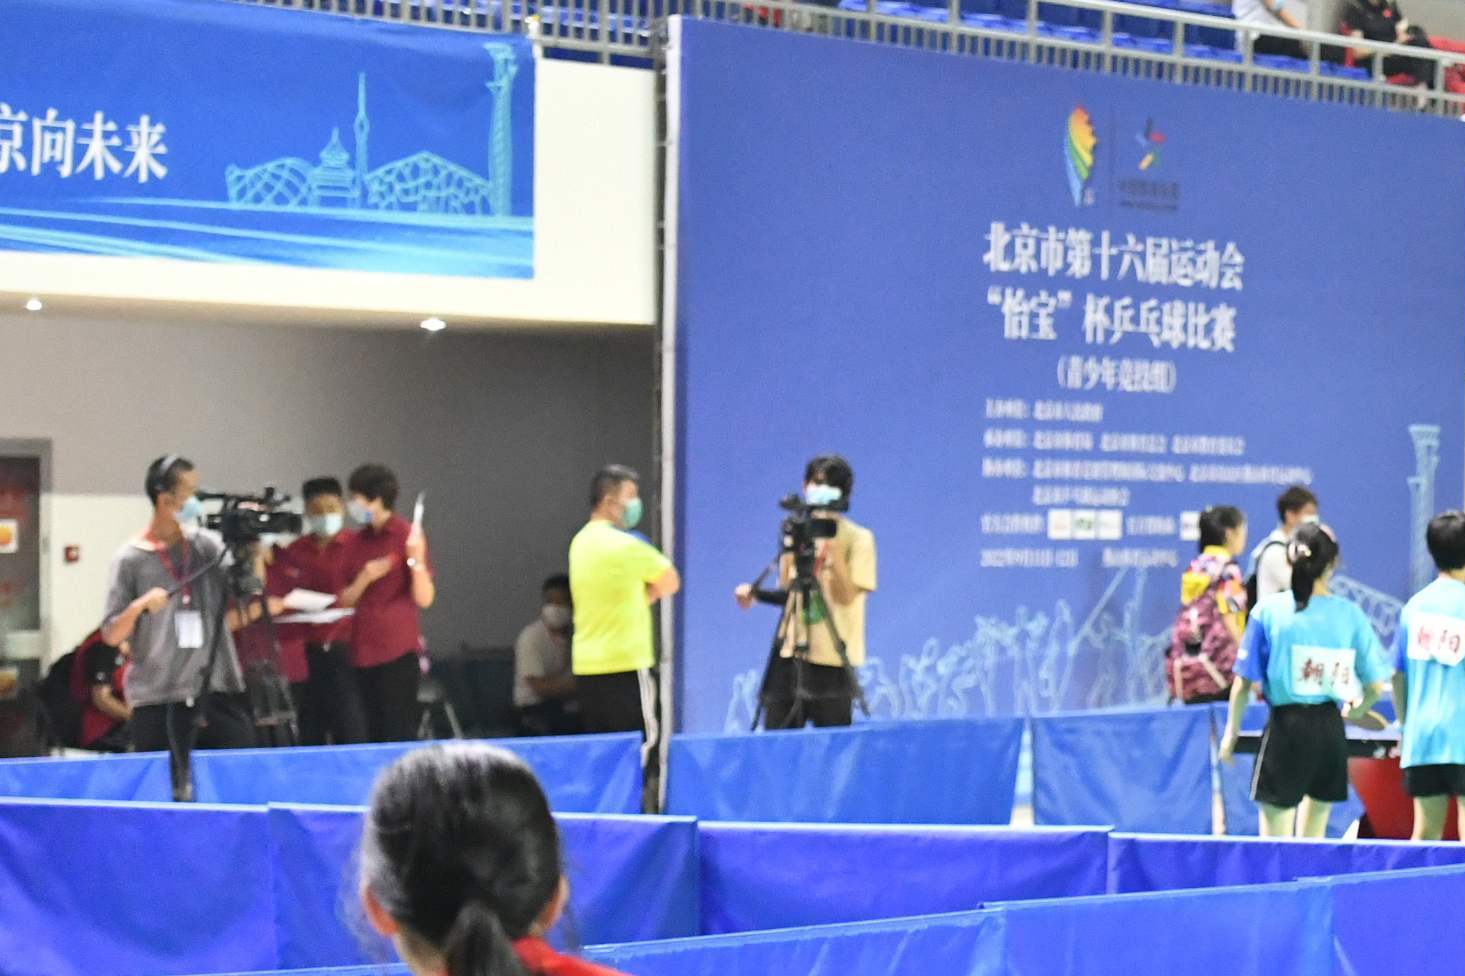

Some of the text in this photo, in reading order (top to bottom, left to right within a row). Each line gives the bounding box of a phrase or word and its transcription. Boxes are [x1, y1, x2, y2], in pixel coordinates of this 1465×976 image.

[0, 102, 169, 184] 京向未来
[983, 221, 1246, 291] 北京市第十六届运动会
[1082, 293, 1238, 353] 杯乒乓球比赛
